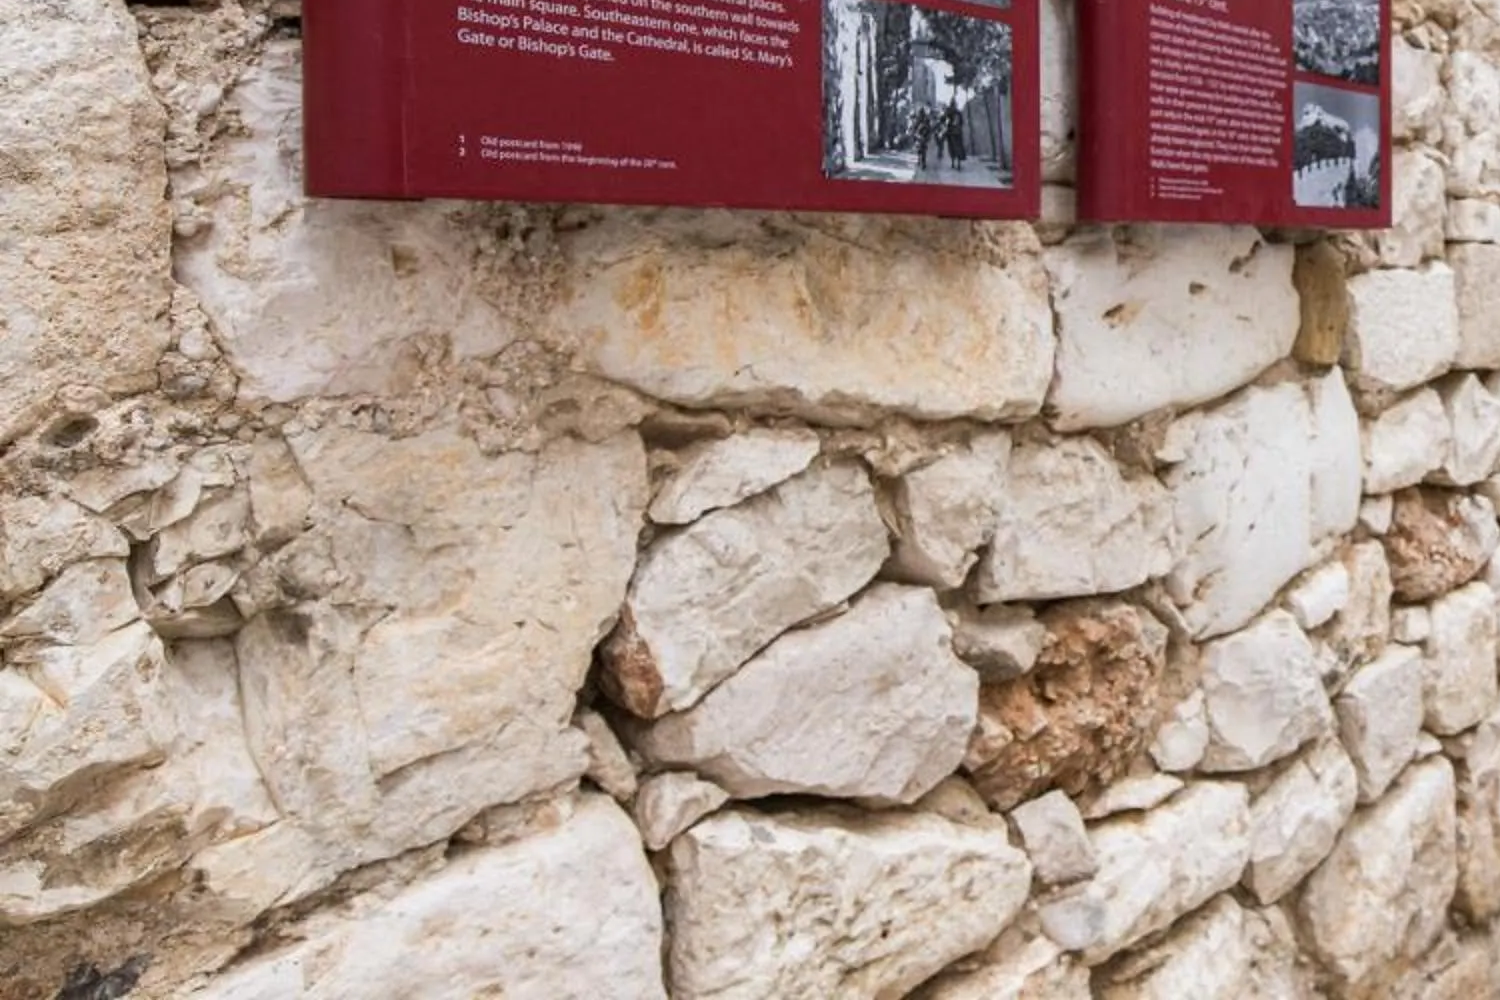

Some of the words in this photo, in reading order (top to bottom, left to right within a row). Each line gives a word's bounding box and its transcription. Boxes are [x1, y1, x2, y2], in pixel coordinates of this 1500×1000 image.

[529, 0, 580, 16] square.
[583, 4, 670, 29] Southeastern
[701, 24, 737, 40] which
[674, 2, 728, 20] southern
[457, 6, 519, 29] Bishop's
[522, 15, 568, 35] Palace
[571, 25, 598, 39] and
[601, 27, 624, 43] the
[626, 31, 690, 53] Cathedral,
[692, 40, 702, 54] is
[704, 43, 739, 59] called
[457, 27, 495, 46] Gate
[497, 36, 515, 48] or
[517, 35, 575, 57] Bishop's
[578, 43, 613, 60] Gate.
